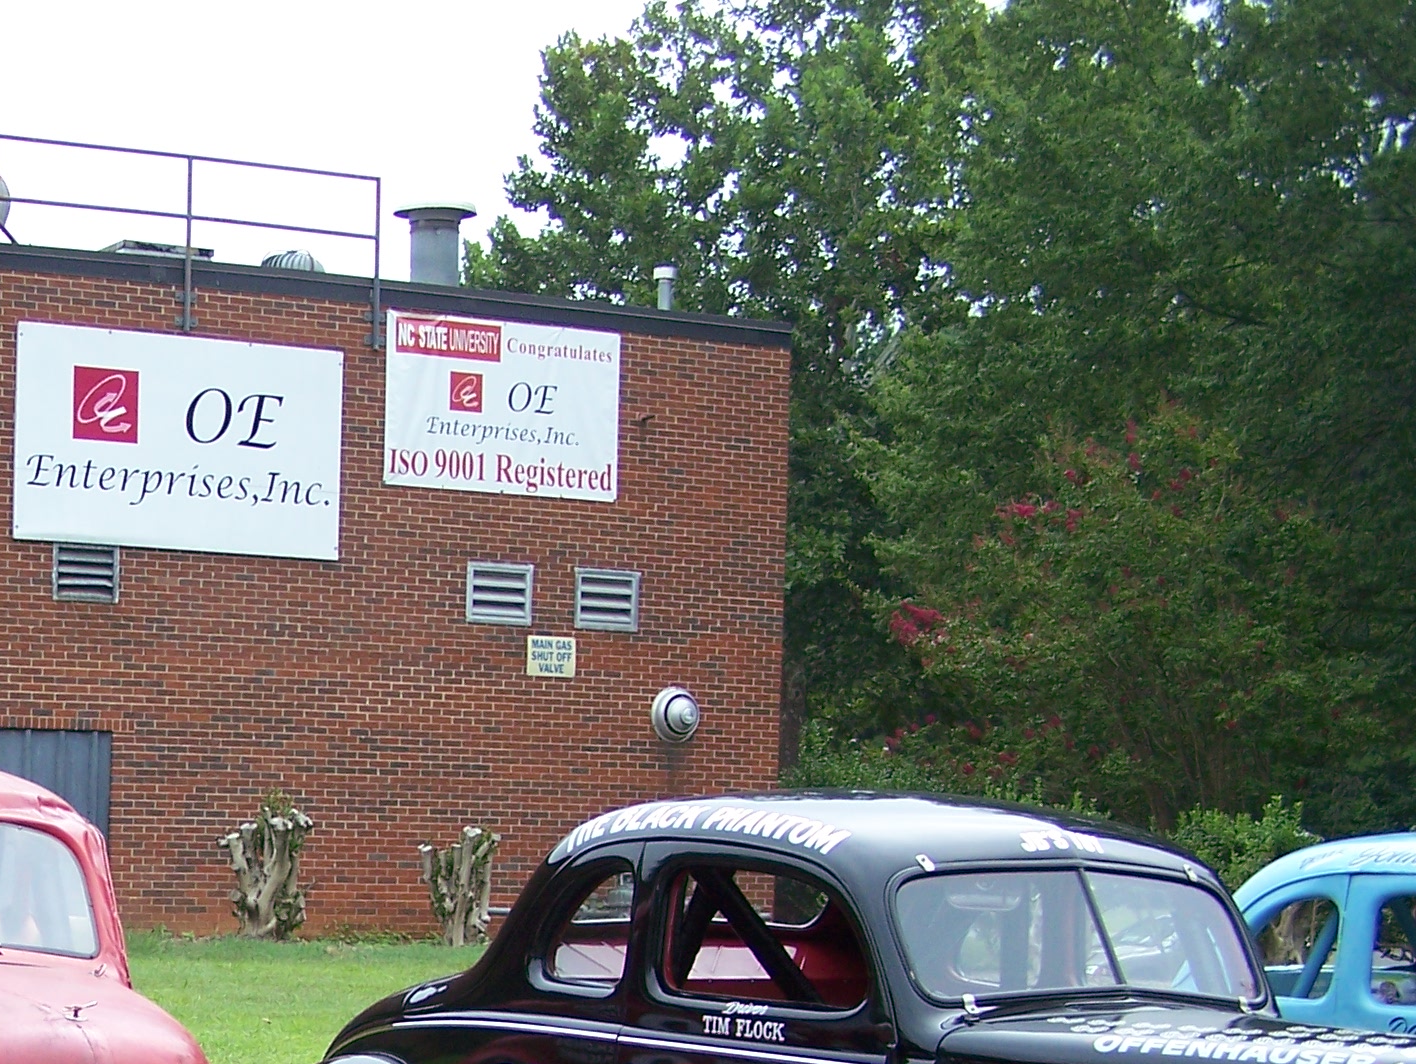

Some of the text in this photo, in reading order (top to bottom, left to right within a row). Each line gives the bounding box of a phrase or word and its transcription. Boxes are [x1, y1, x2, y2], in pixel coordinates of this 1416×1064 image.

[397, 322, 500, 355] NC STATE UNIVERSITY
[506, 336, 613, 363] Congratulates
[507, 381, 559, 415] OE
[185, 387, 285, 450] OE
[388, 448, 613, 494] ISO 9001 Registered
[531, 639, 572, 650] MAIN GAS
[531, 650, 572, 662] SHUT OFF
[538, 662, 565, 674] VALVE
[566, 804, 853, 855] THE BLACK PHANTOM
[702, 1015, 786, 1042] TIM FLOCK
